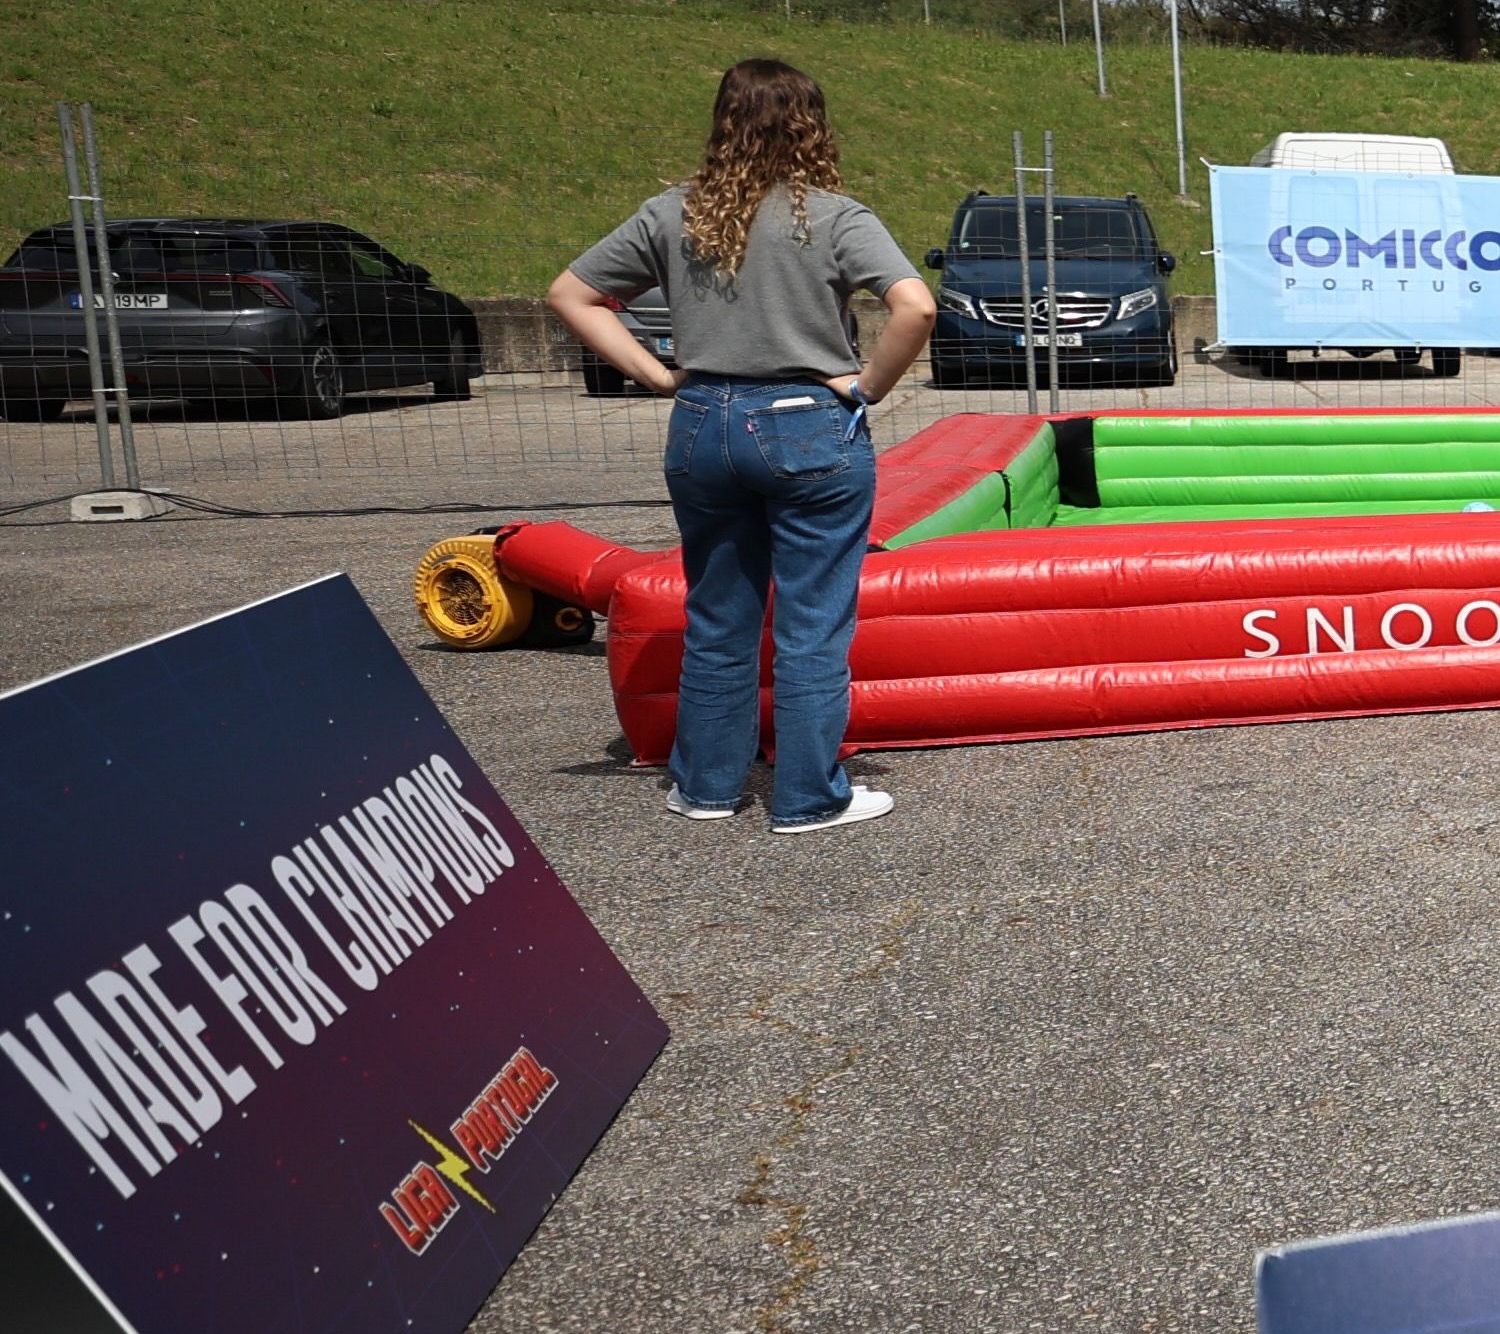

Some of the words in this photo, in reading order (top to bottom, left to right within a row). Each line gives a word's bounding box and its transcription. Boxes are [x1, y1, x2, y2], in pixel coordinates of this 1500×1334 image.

[0, 944, 258, 1200] MADE
[167, 883, 348, 1069] FOR
[271, 754, 516, 991] CHAMPIONS
[379, 1161, 460, 1256] LIGA
[449, 1046, 559, 1174] PORTUGAL
